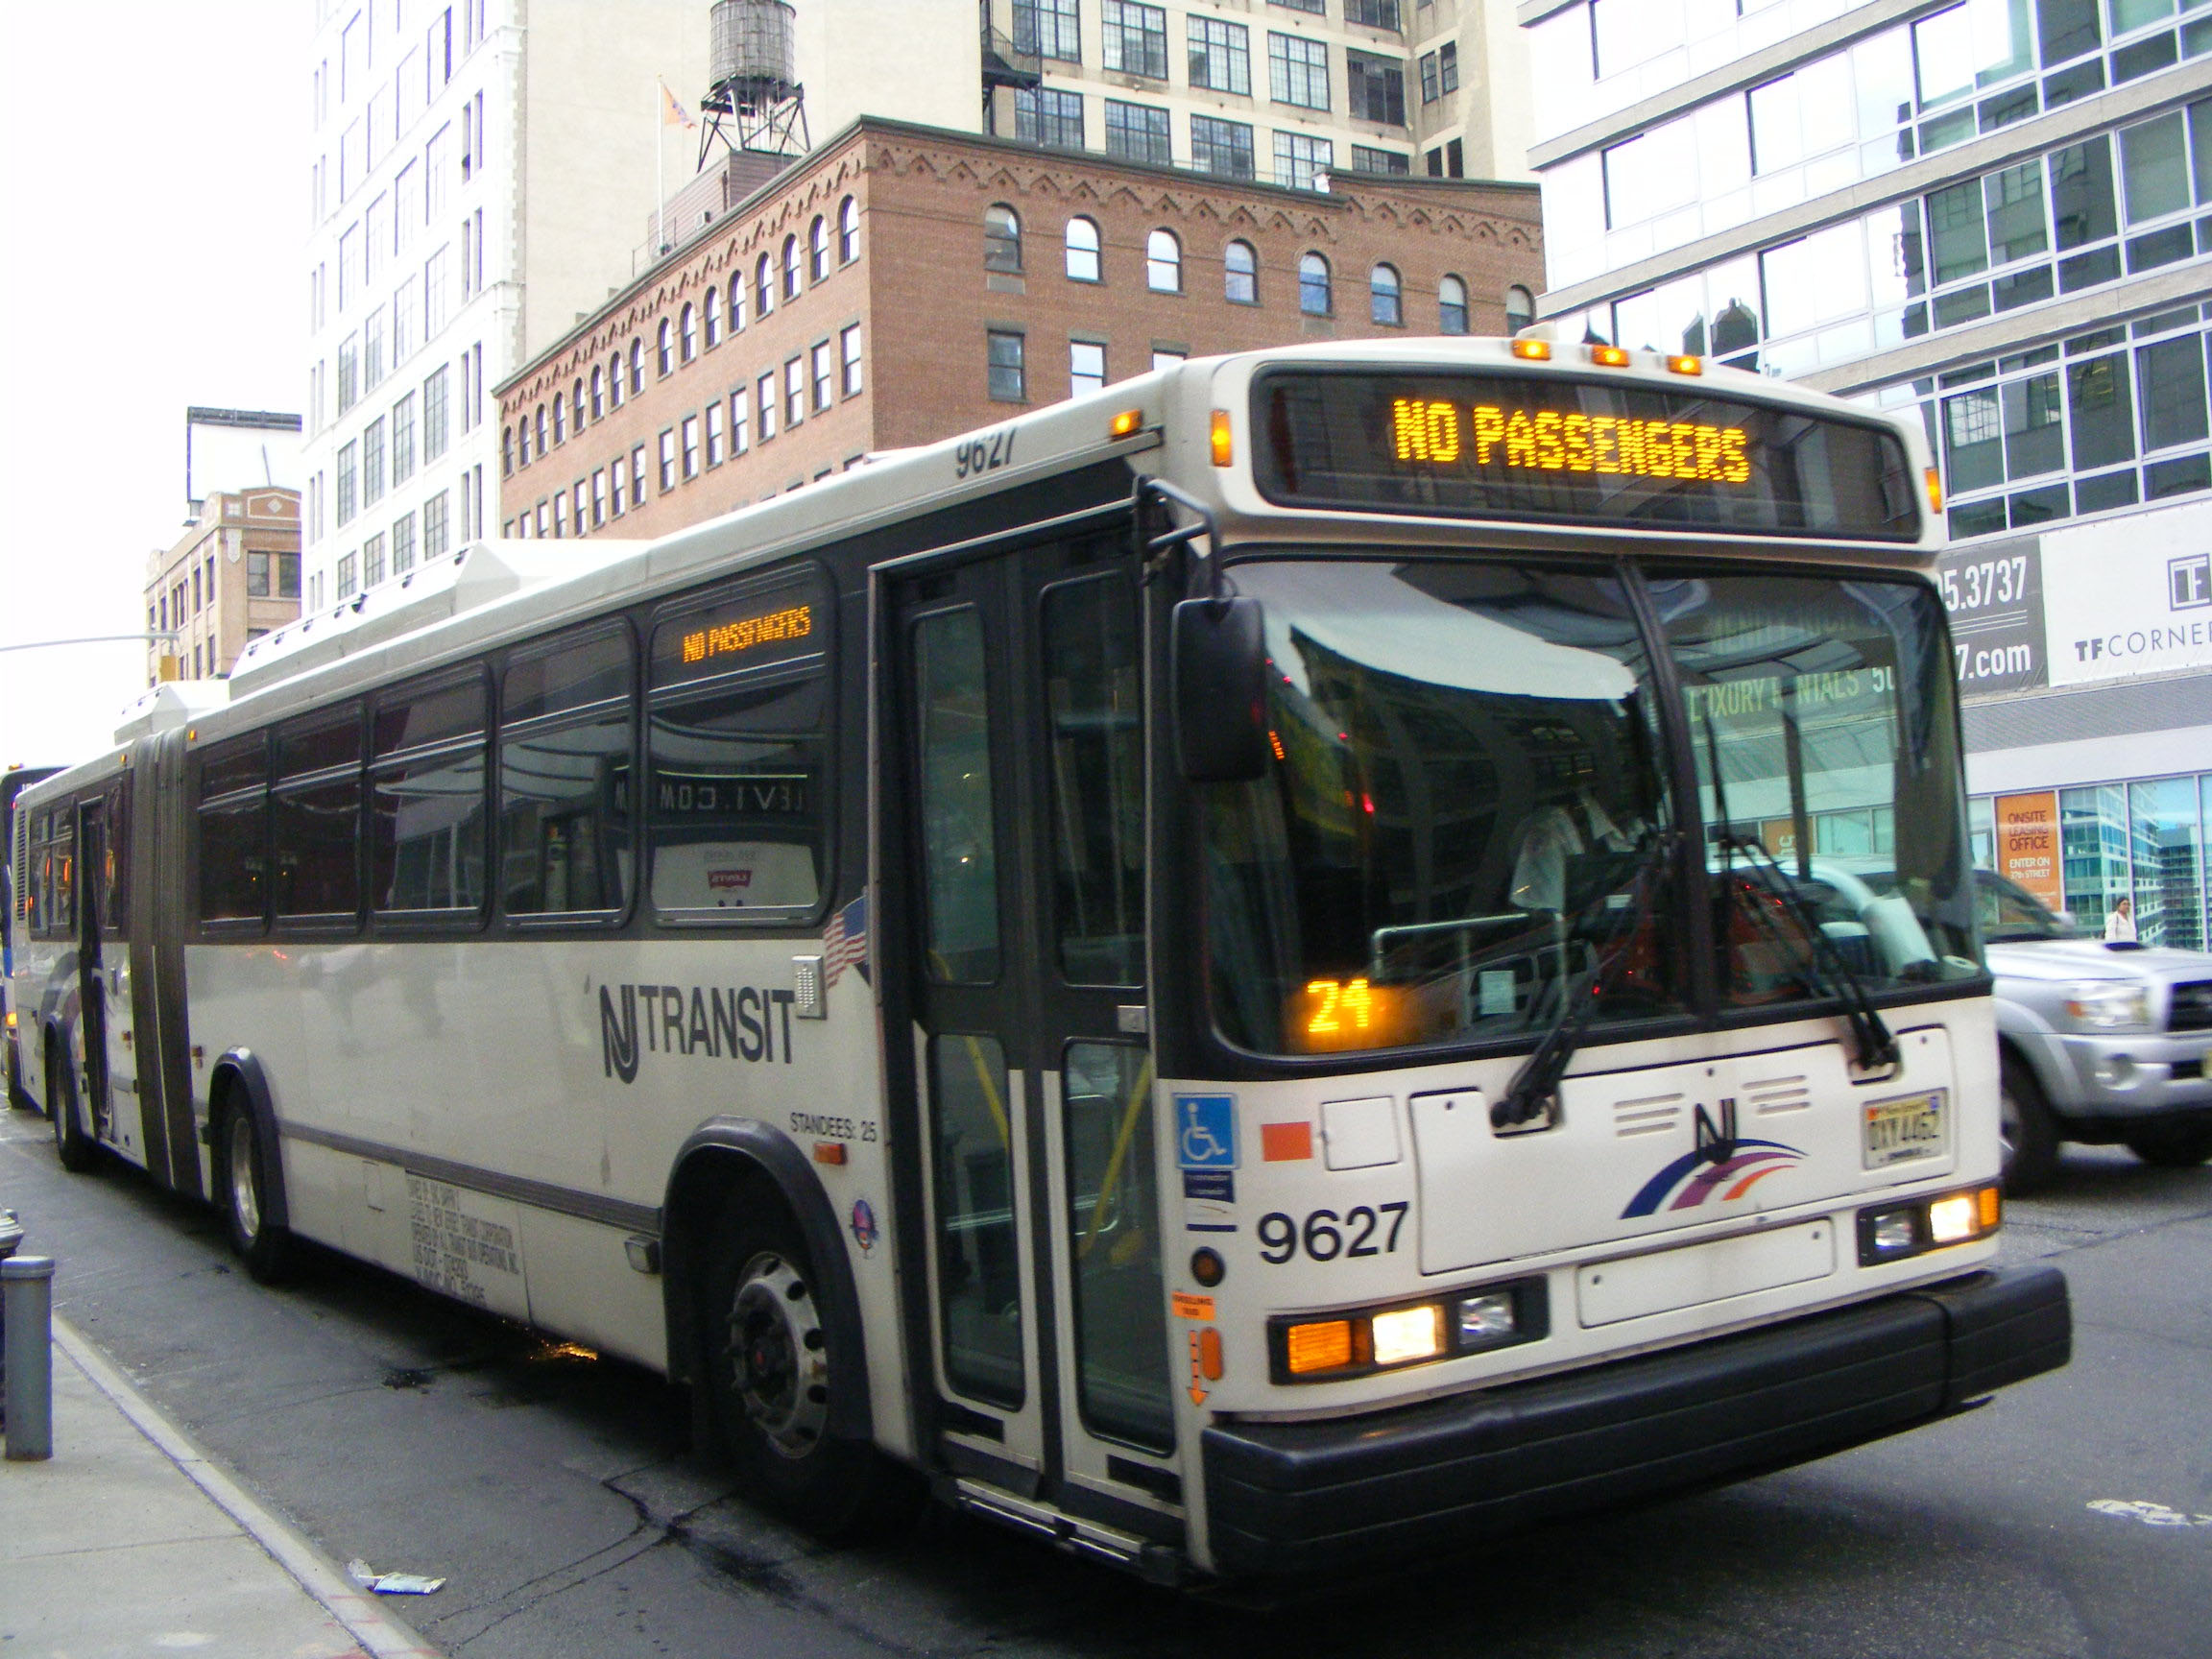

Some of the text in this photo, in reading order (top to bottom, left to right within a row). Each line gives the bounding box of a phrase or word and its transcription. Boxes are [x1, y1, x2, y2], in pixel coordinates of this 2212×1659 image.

[956, 428, 1016, 479] 9627
[1394, 398, 1750, 483] NO PASSENGERS
[1936, 556, 2027, 612] 5.3737
[684, 606, 811, 663] NO PASSENGERS
[2008, 810, 2047, 824] ONSITE
[2009, 835, 2050, 851] OFFICE
[2009, 856, 2050, 869] ENTER ON
[2025, 869, 2050, 879] STREET
[1307, 978, 1372, 1033] 24
[861, 1121, 878, 1142] 25
[1258, 1201, 1409, 1263] 9627
